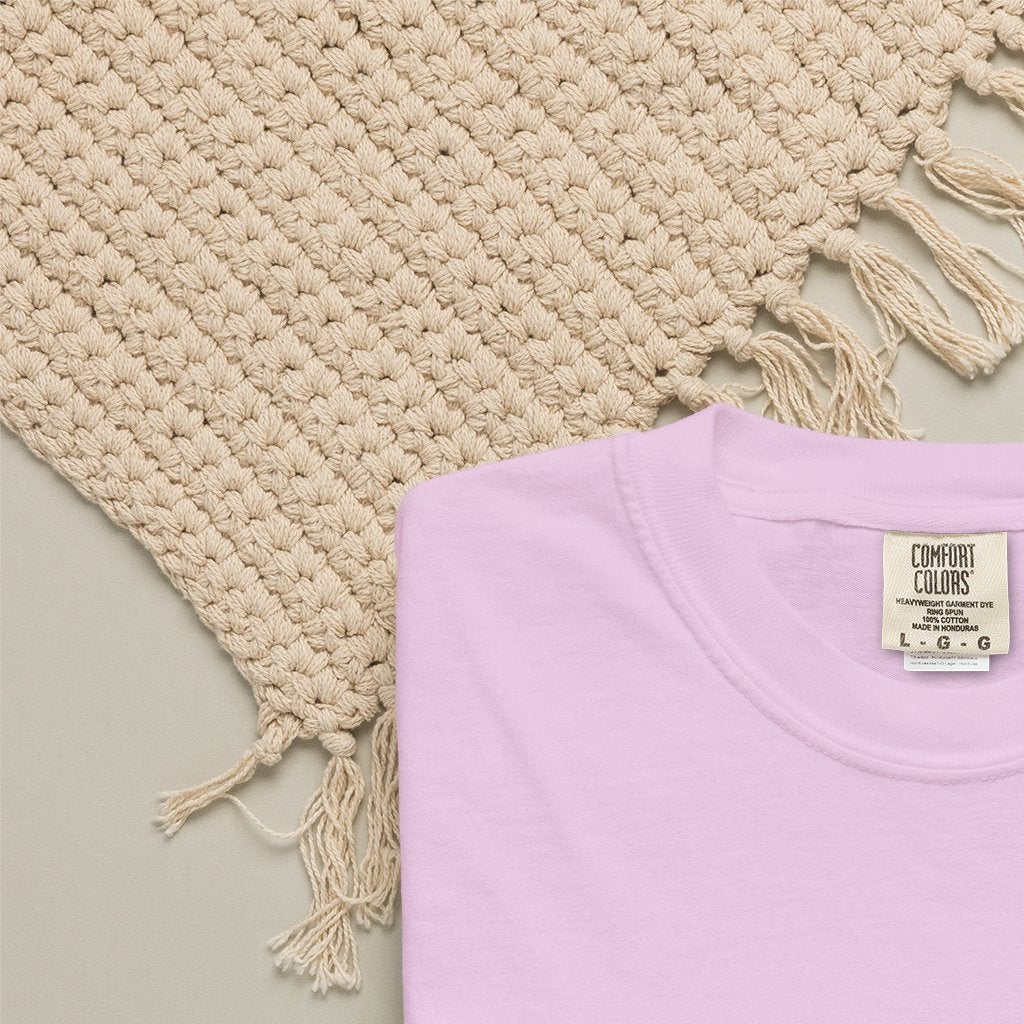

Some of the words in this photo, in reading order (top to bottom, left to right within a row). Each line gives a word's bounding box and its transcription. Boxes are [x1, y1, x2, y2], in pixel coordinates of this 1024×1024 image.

[911, 543, 976, 568] COMFORT
[895, 598, 944, 608] HEAVYWEIGHT
[945, 600, 979, 608] GARMENT
[980, 601, 994, 609] DYE
[926, 608, 944, 616] RING
[922, 616, 940, 624] 100%
[912, 623, 932, 632] MADE
[932, 624, 940, 632] IN
[941, 624, 979, 632] HONDURAS
[900, 632, 910, 647] L
[936, 635, 950, 650] G
[977, 635, 991, 650] G
